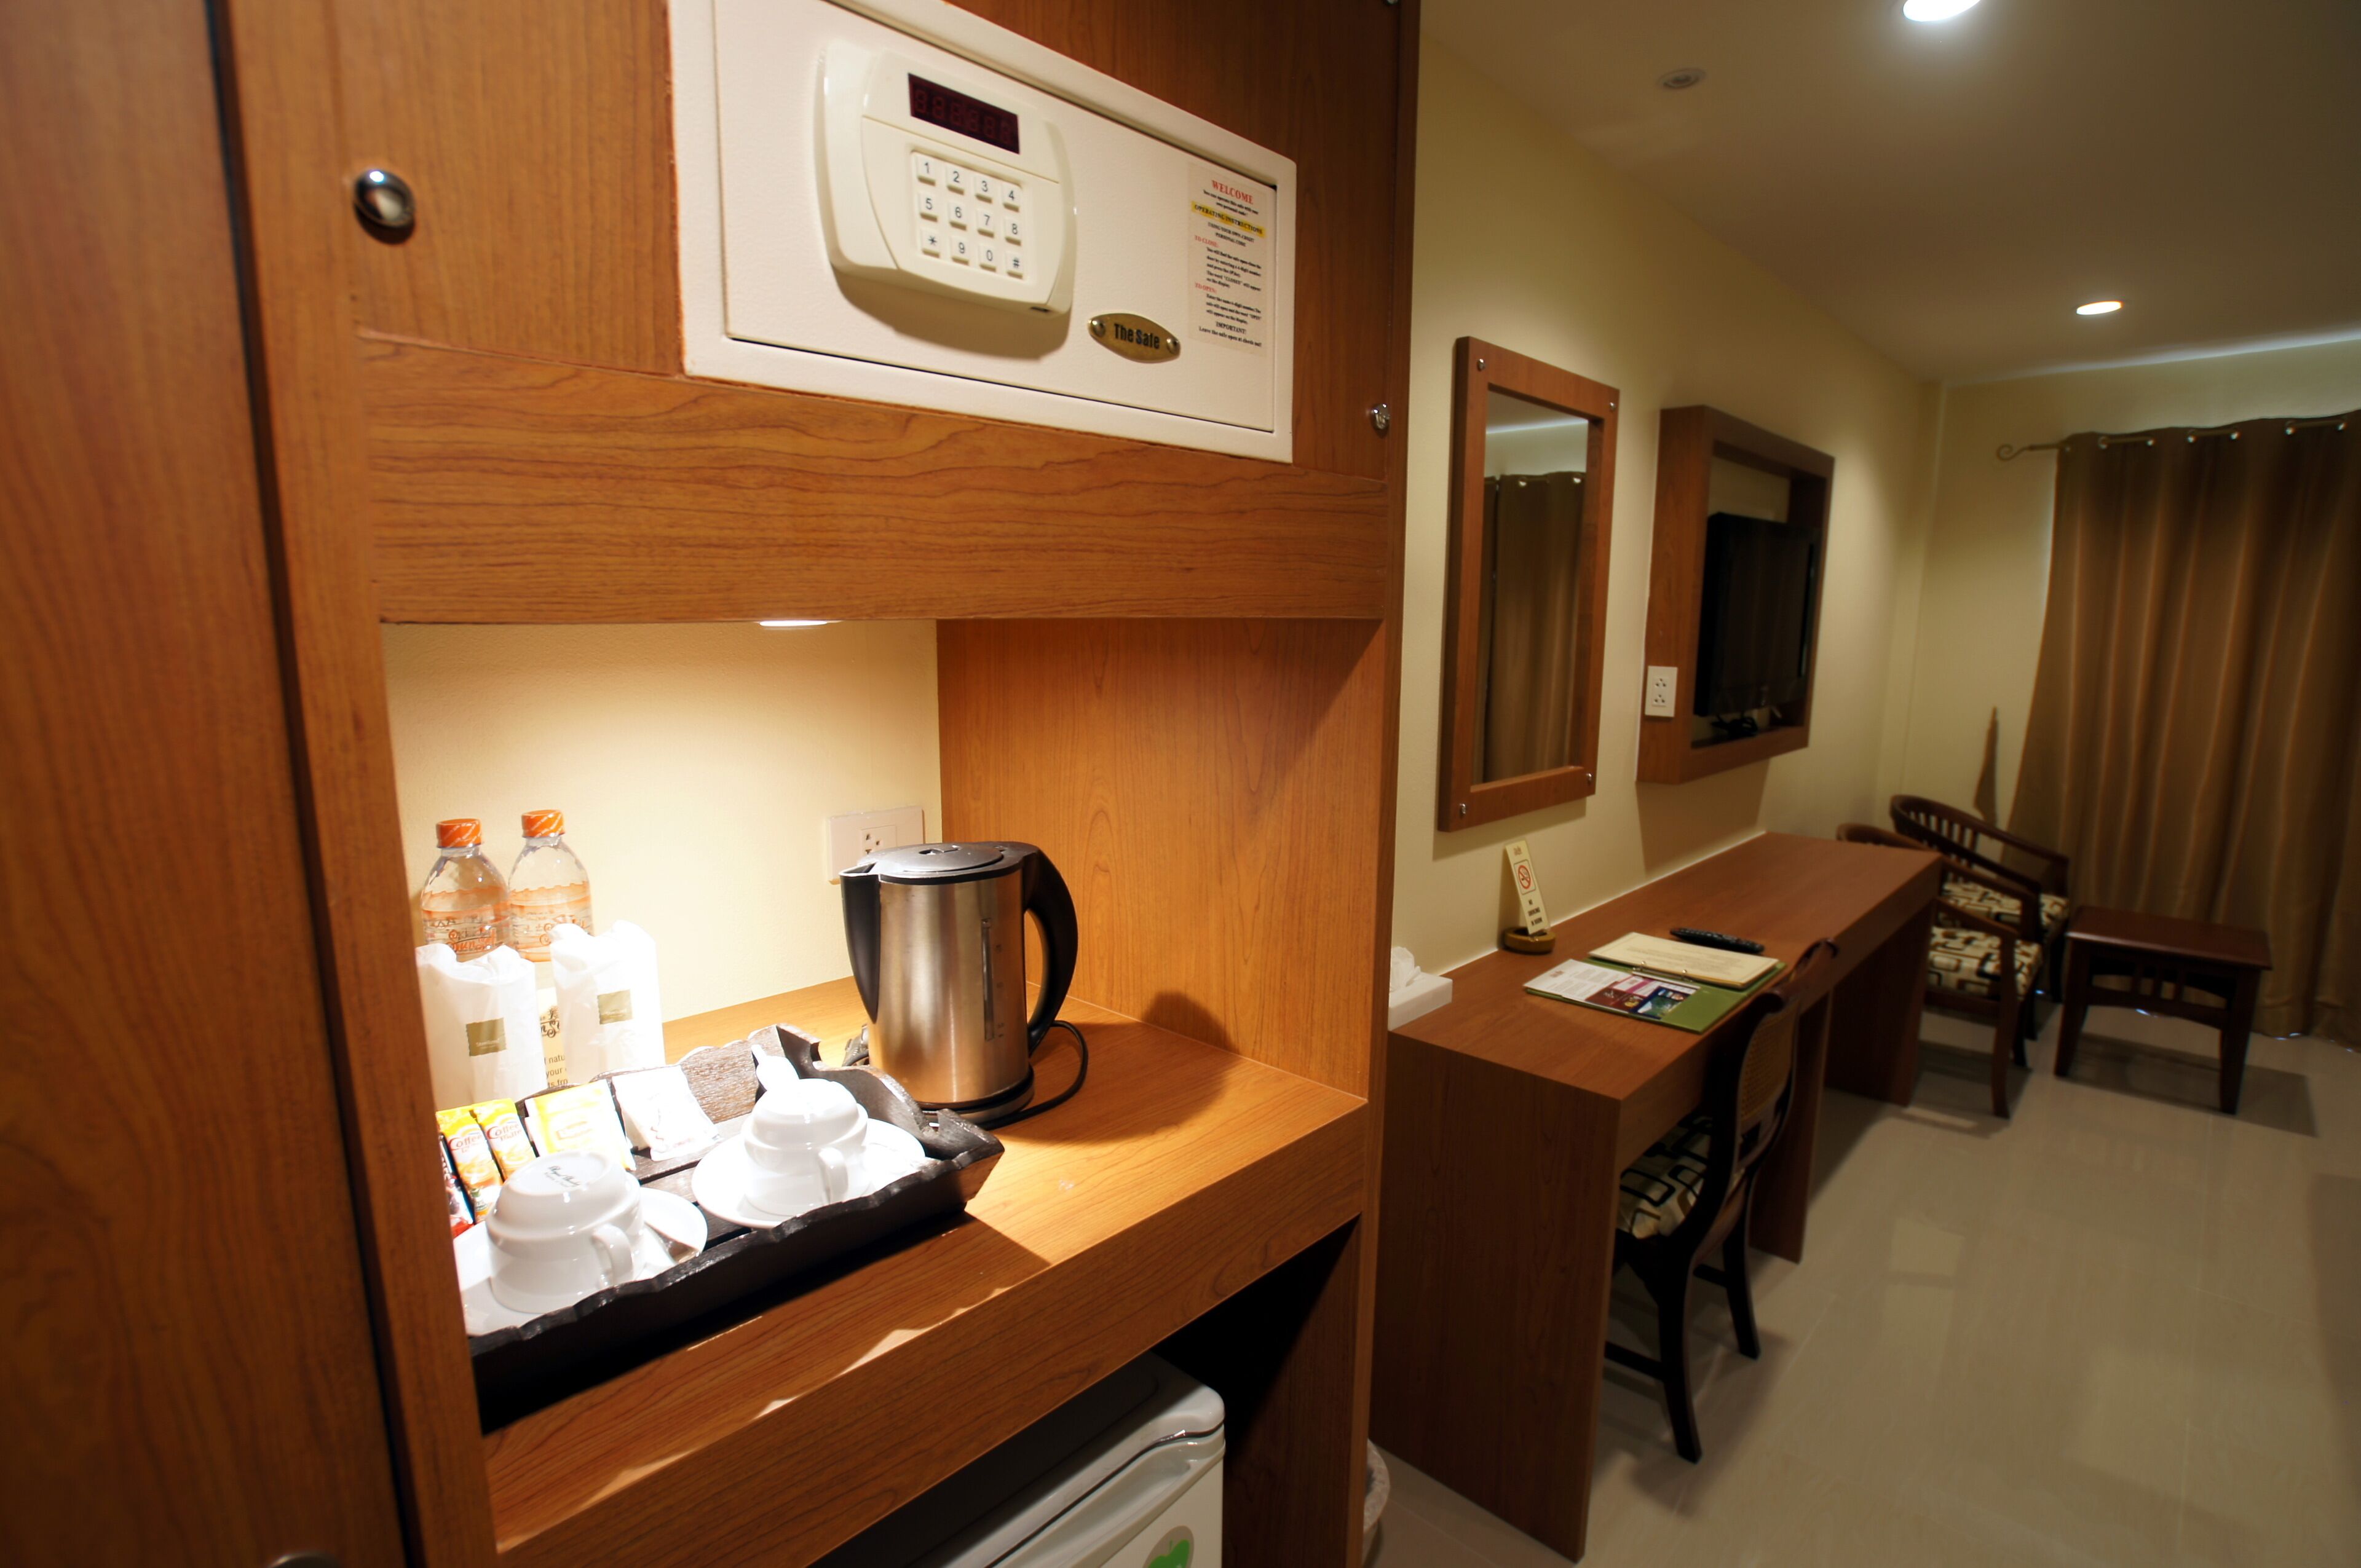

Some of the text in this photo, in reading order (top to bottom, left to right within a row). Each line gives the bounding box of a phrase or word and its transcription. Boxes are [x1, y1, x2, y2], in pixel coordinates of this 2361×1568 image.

[924, 162, 1014, 200] 1 2 3 4
[1212, 179, 1254, 205] WELCOME
[926, 199, 1018, 235] 5 6 7 8
[1195, 204, 1262, 234] OPERATING INSTRUCTIONS
[959, 243, 965, 253] 9
[986, 250, 993, 261] 0
[1114, 323, 1160, 349] The Safe
[486, 1124, 519, 1139] Coffee
